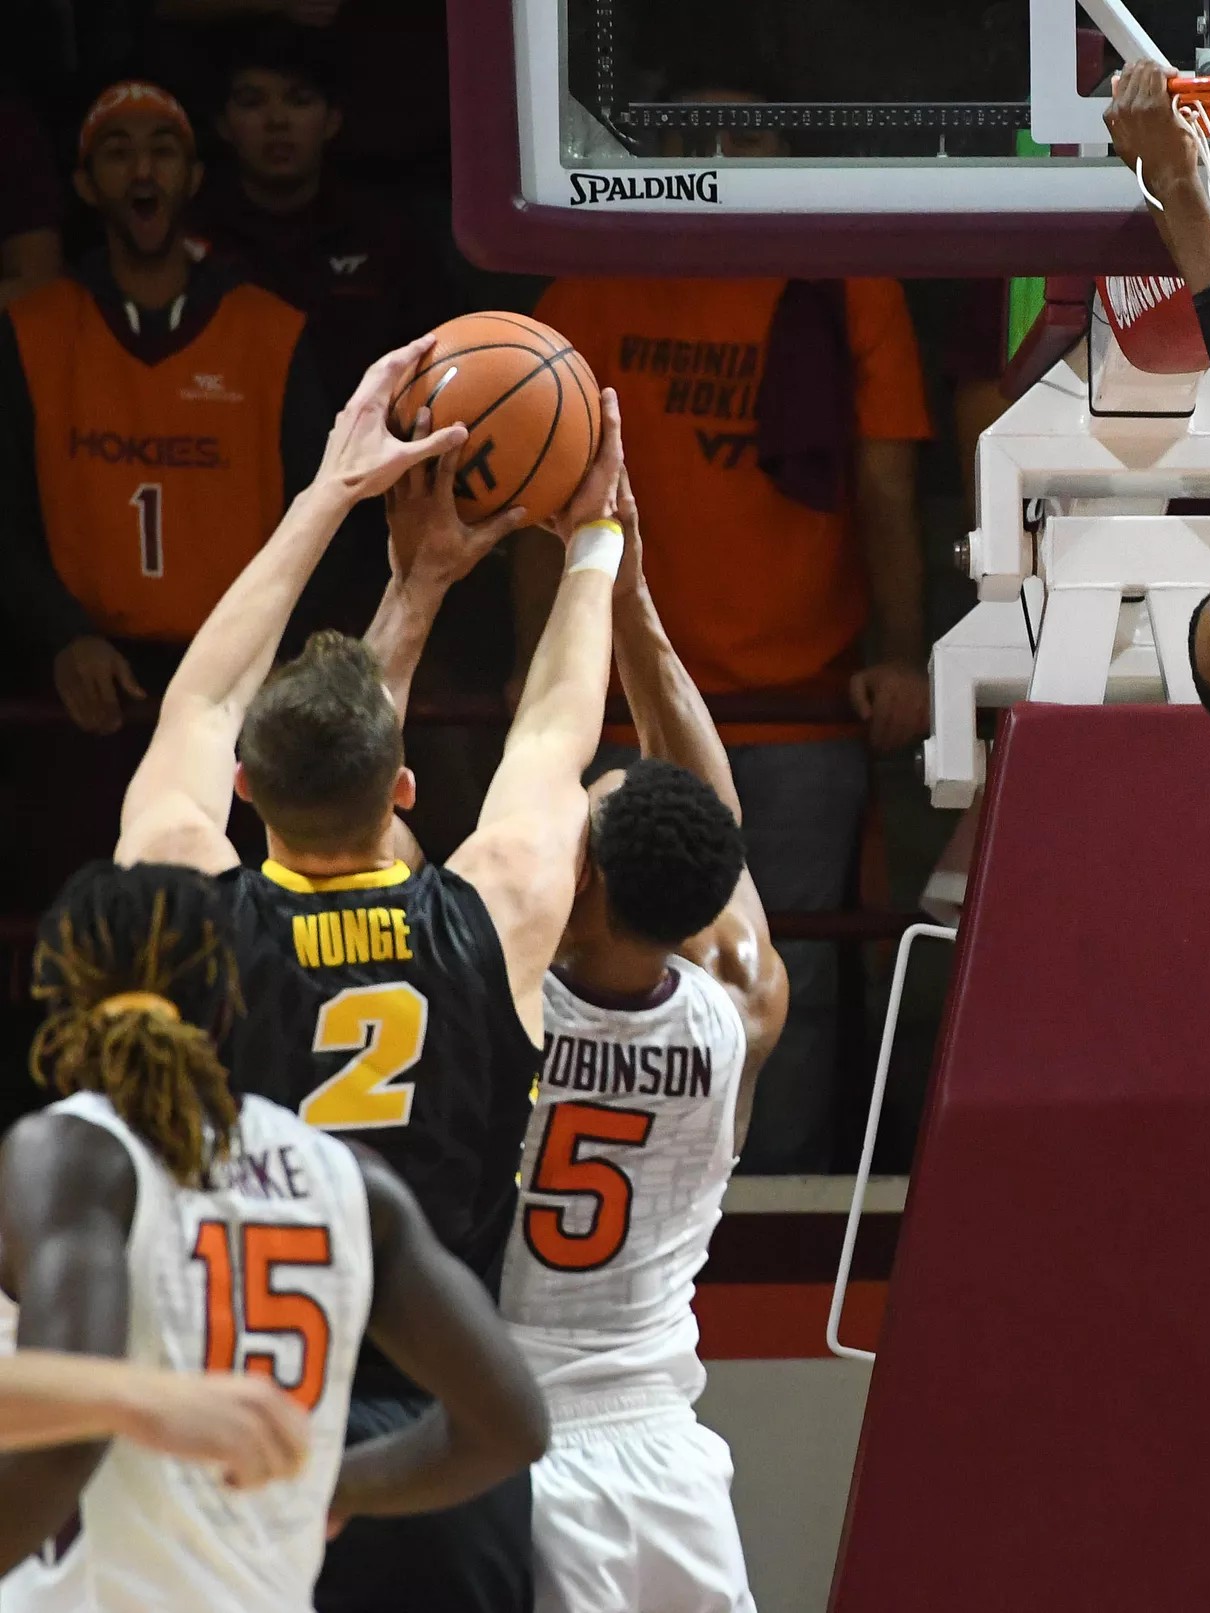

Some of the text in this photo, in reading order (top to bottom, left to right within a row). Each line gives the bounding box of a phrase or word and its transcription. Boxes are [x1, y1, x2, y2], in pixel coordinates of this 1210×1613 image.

[570, 171, 718, 205] SPALDING
[620, 335, 757, 378] VIRGINIA
[665, 380, 758, 420] HOKI
[68, 425, 219, 468] HOKIES
[128, 482, 165, 579] 1
[292, 906, 414, 968] NUNGE
[299, 980, 429, 1132] 2
[523, 1100, 656, 1273] 5
[191, 1219, 333, 1415] 15
